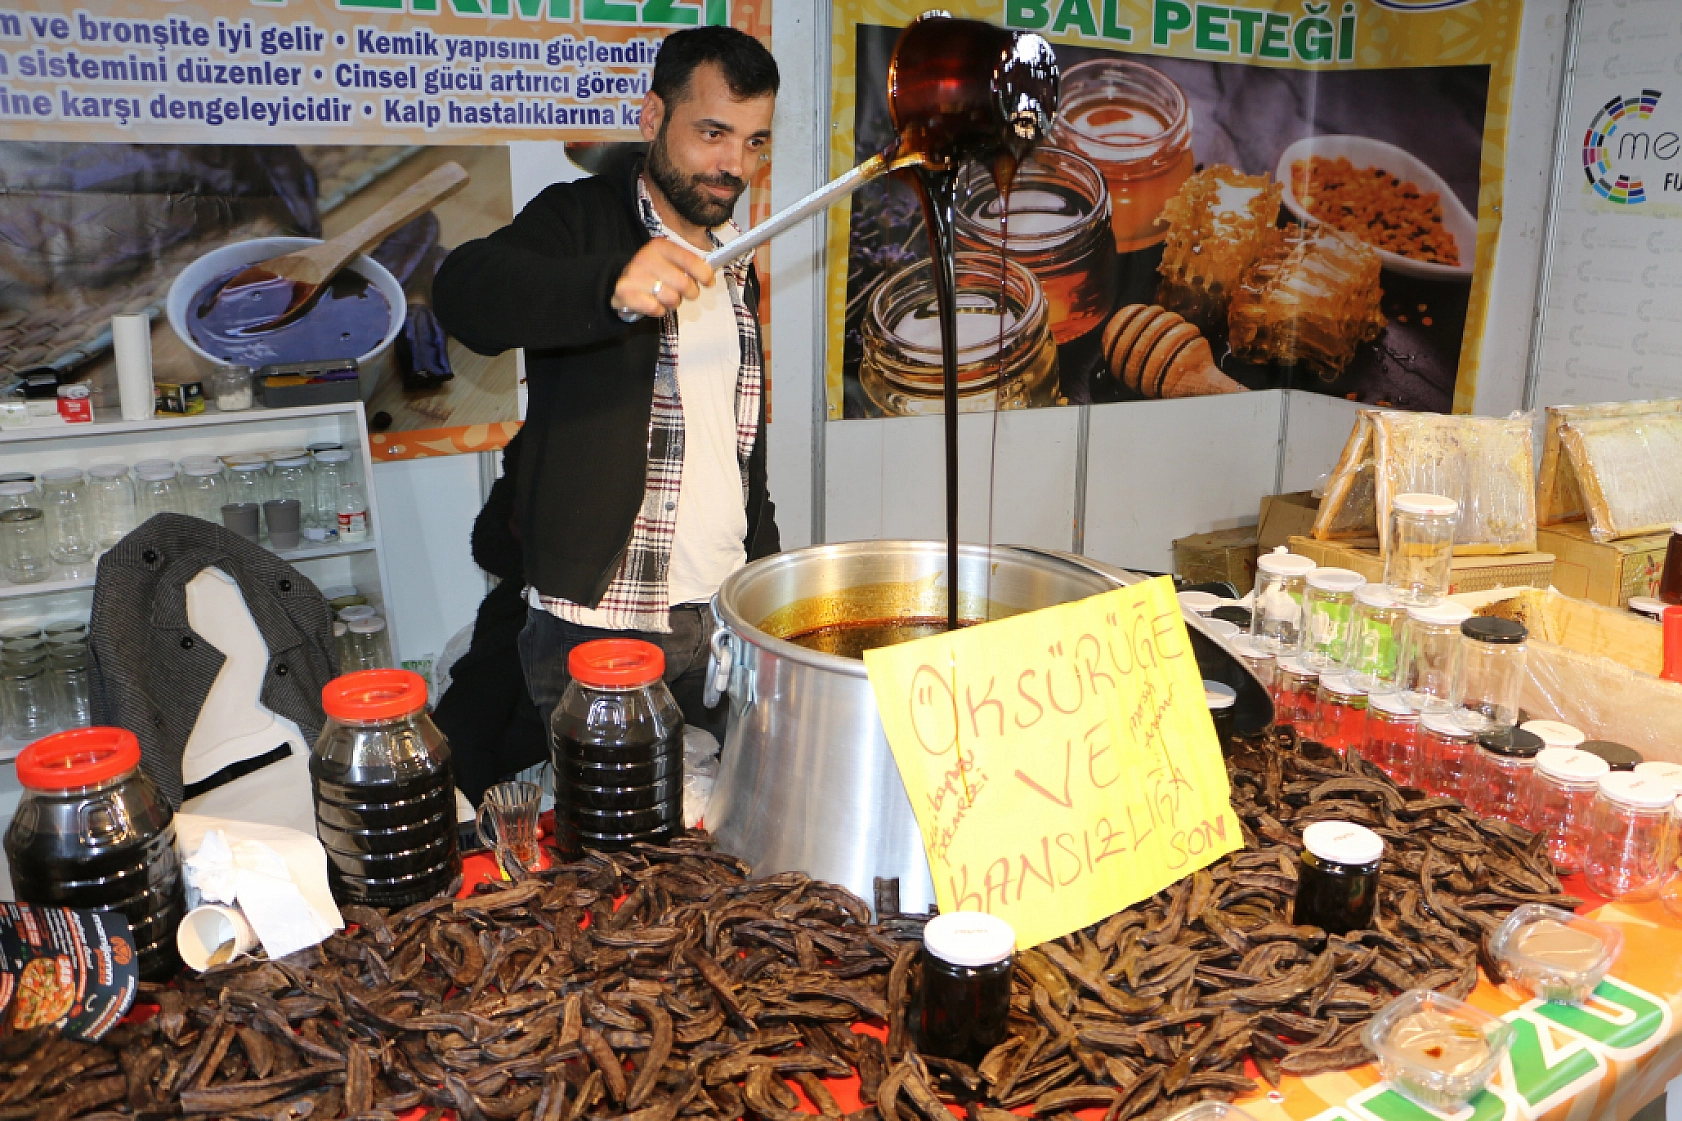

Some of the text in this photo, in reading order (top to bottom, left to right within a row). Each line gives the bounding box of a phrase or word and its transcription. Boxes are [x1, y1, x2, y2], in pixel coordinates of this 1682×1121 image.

[30, 15, 70, 40] ve
[78, 13, 209, 51] bronşite
[218, 21, 252, 53] iyi
[261, 24, 324, 54] gelir
[357, 29, 437, 57] Kemik
[445, 39, 539, 60] yapısını
[1007, 0, 1354, 61] BAL PETEĞİ
[18, 49, 167, 82] sistemini
[177, 58, 301, 85] düzenler
[335, 63, 416, 89] Cinsel
[424, 67, 482, 94] gücü
[490, 73, 569, 93] artırıcı
[576, 71, 647, 98] görevi
[62, 90, 140, 124] karşı
[150, 94, 352, 126] dengeleyicidir
[385, 99, 440, 126] Kalp
[448, 100, 616, 125] hastalıklarına
[1014, 720, 1120, 809] VE
[1168, 814, 1226, 870] SON
